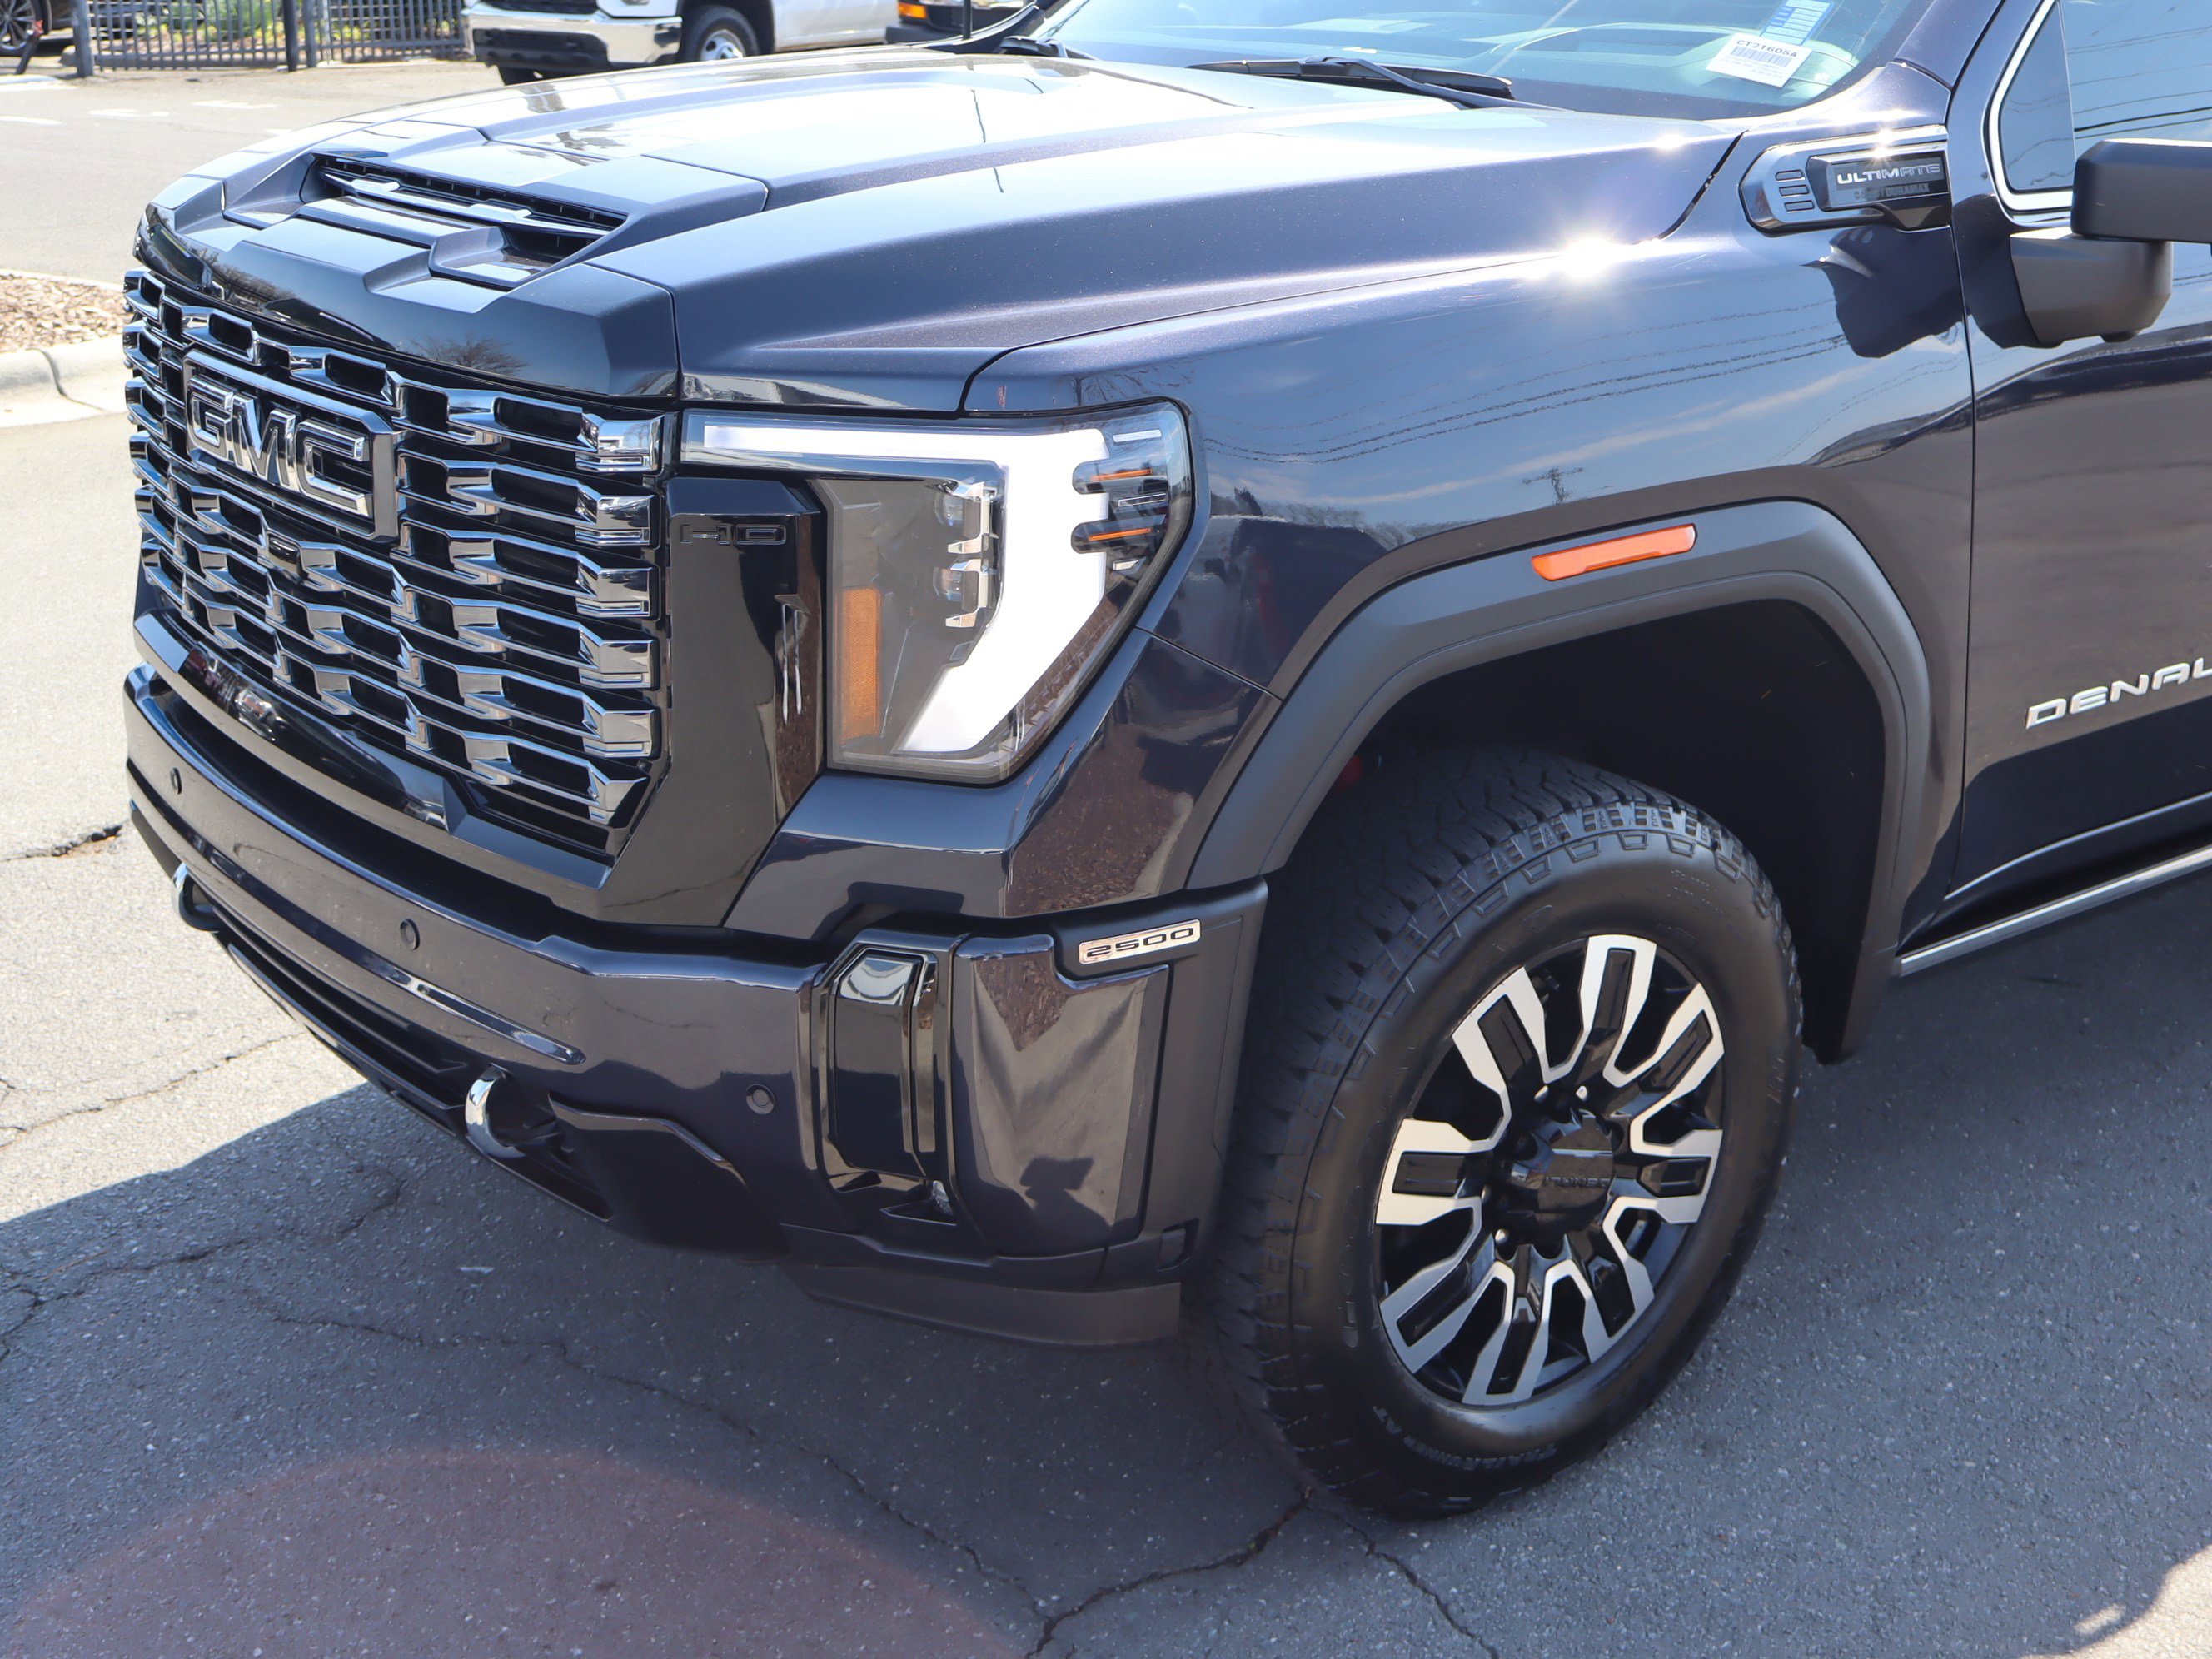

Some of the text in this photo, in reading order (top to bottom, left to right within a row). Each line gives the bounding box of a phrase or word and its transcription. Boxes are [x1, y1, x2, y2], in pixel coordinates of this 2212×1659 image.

[1736, 39, 1798, 57] CT21605A
[1836, 163, 1941, 185] ULTIMATE
[186, 375, 371, 517] GMC
[680, 523, 787, 546] HD
[1085, 927, 1194, 957] 2500
